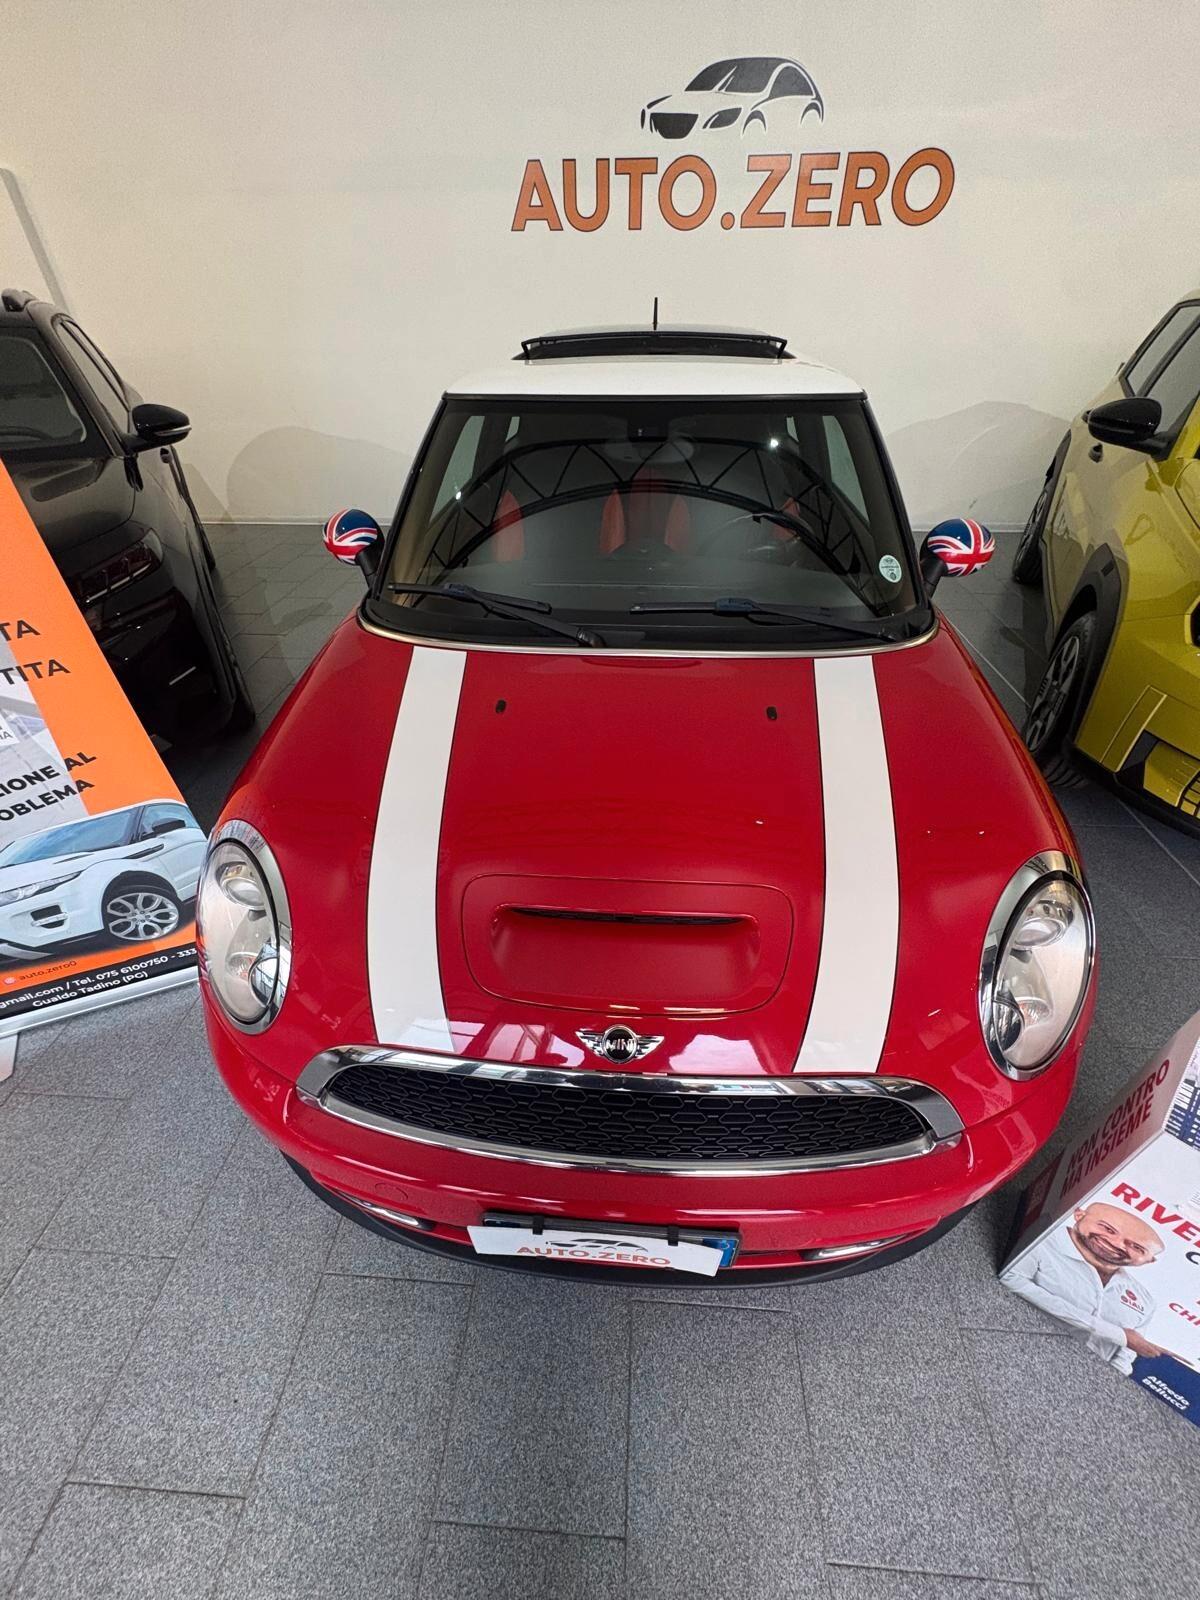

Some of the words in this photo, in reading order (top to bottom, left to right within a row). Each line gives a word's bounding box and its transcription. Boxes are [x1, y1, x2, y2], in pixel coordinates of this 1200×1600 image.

[510, 147, 955, 232] AUTO.ZERO
[0, 765, 61, 798] IONE
[64, 752, 97, 772] AL
[0, 779, 95, 821] OBLEMA
[19, 960, 78, 980] auto.zero0
[72, 976, 96, 987] Tel.
[96, 969, 119, 981] 075
[120, 955, 169, 974] 6100750
[176, 947, 198, 958] 333
[78, 979, 121, 994] Tadino
[122, 970, 149, 983] (PG)
[605, 1038, 635, 1052] MINI
[1066, 1126, 1101, 1174] NON
[1101, 1059, 1170, 1139] CONTRO
[1060, 1162, 1084, 1199] MA
[1084, 1093, 1155, 1177] INSIEME
[1110, 1182, 1200, 1248] RIVE
[516, 1246, 671, 1265] AUTO.ZERO
[1141, 1377, 1188, 1410] Bellucci
[1147, 1375, 1190, 1406] Alfredo
